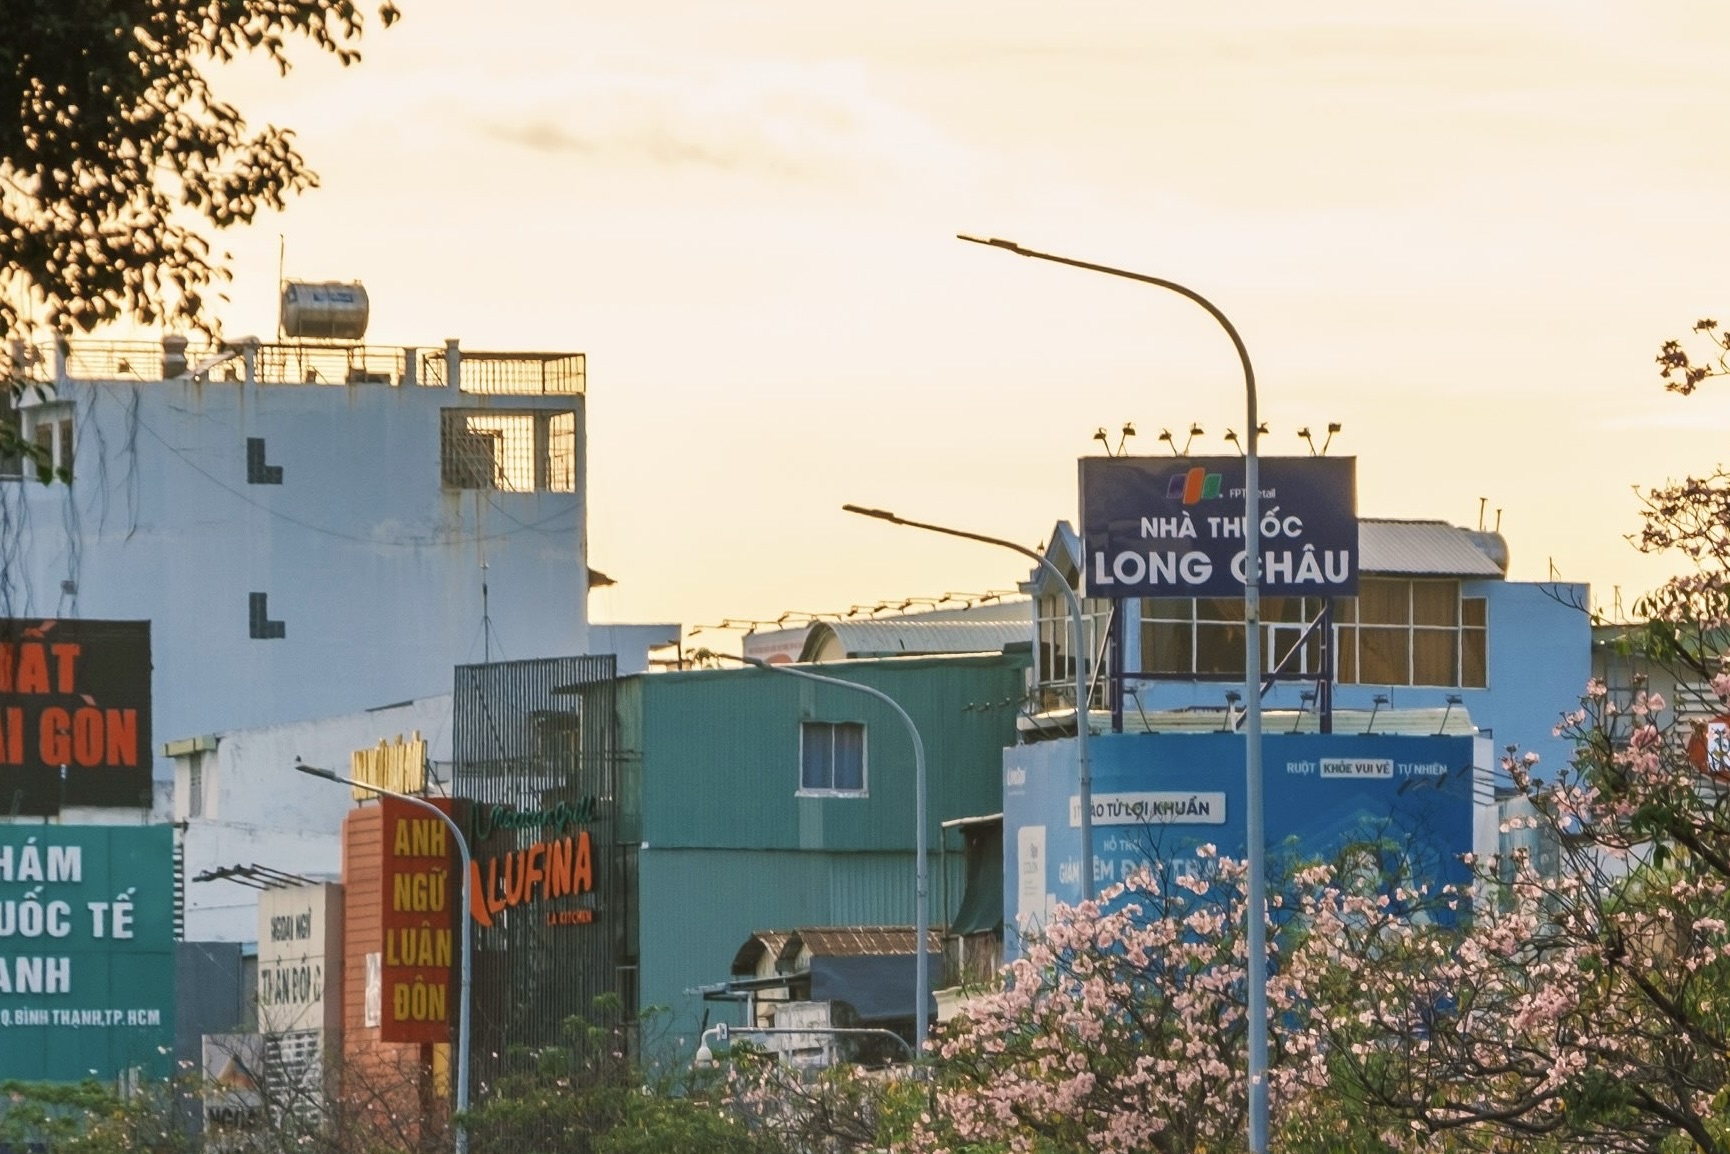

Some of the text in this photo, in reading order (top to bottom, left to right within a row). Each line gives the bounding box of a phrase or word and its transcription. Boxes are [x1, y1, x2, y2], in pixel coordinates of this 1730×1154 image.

[1140, 506, 1304, 539] NHÀ THỐC
[1094, 544, 1350, 585] LONG CHÂU
[39, 693, 138, 768] GÒN
[1355, 762, 1373, 774] VUI
[394, 818, 447, 857] ANH
[394, 866, 448, 912] NGỮ
[87, 886, 137, 939] TẾ
[386, 921, 452, 967] LUÂN
[394, 974, 446, 1022] ĐÔN
